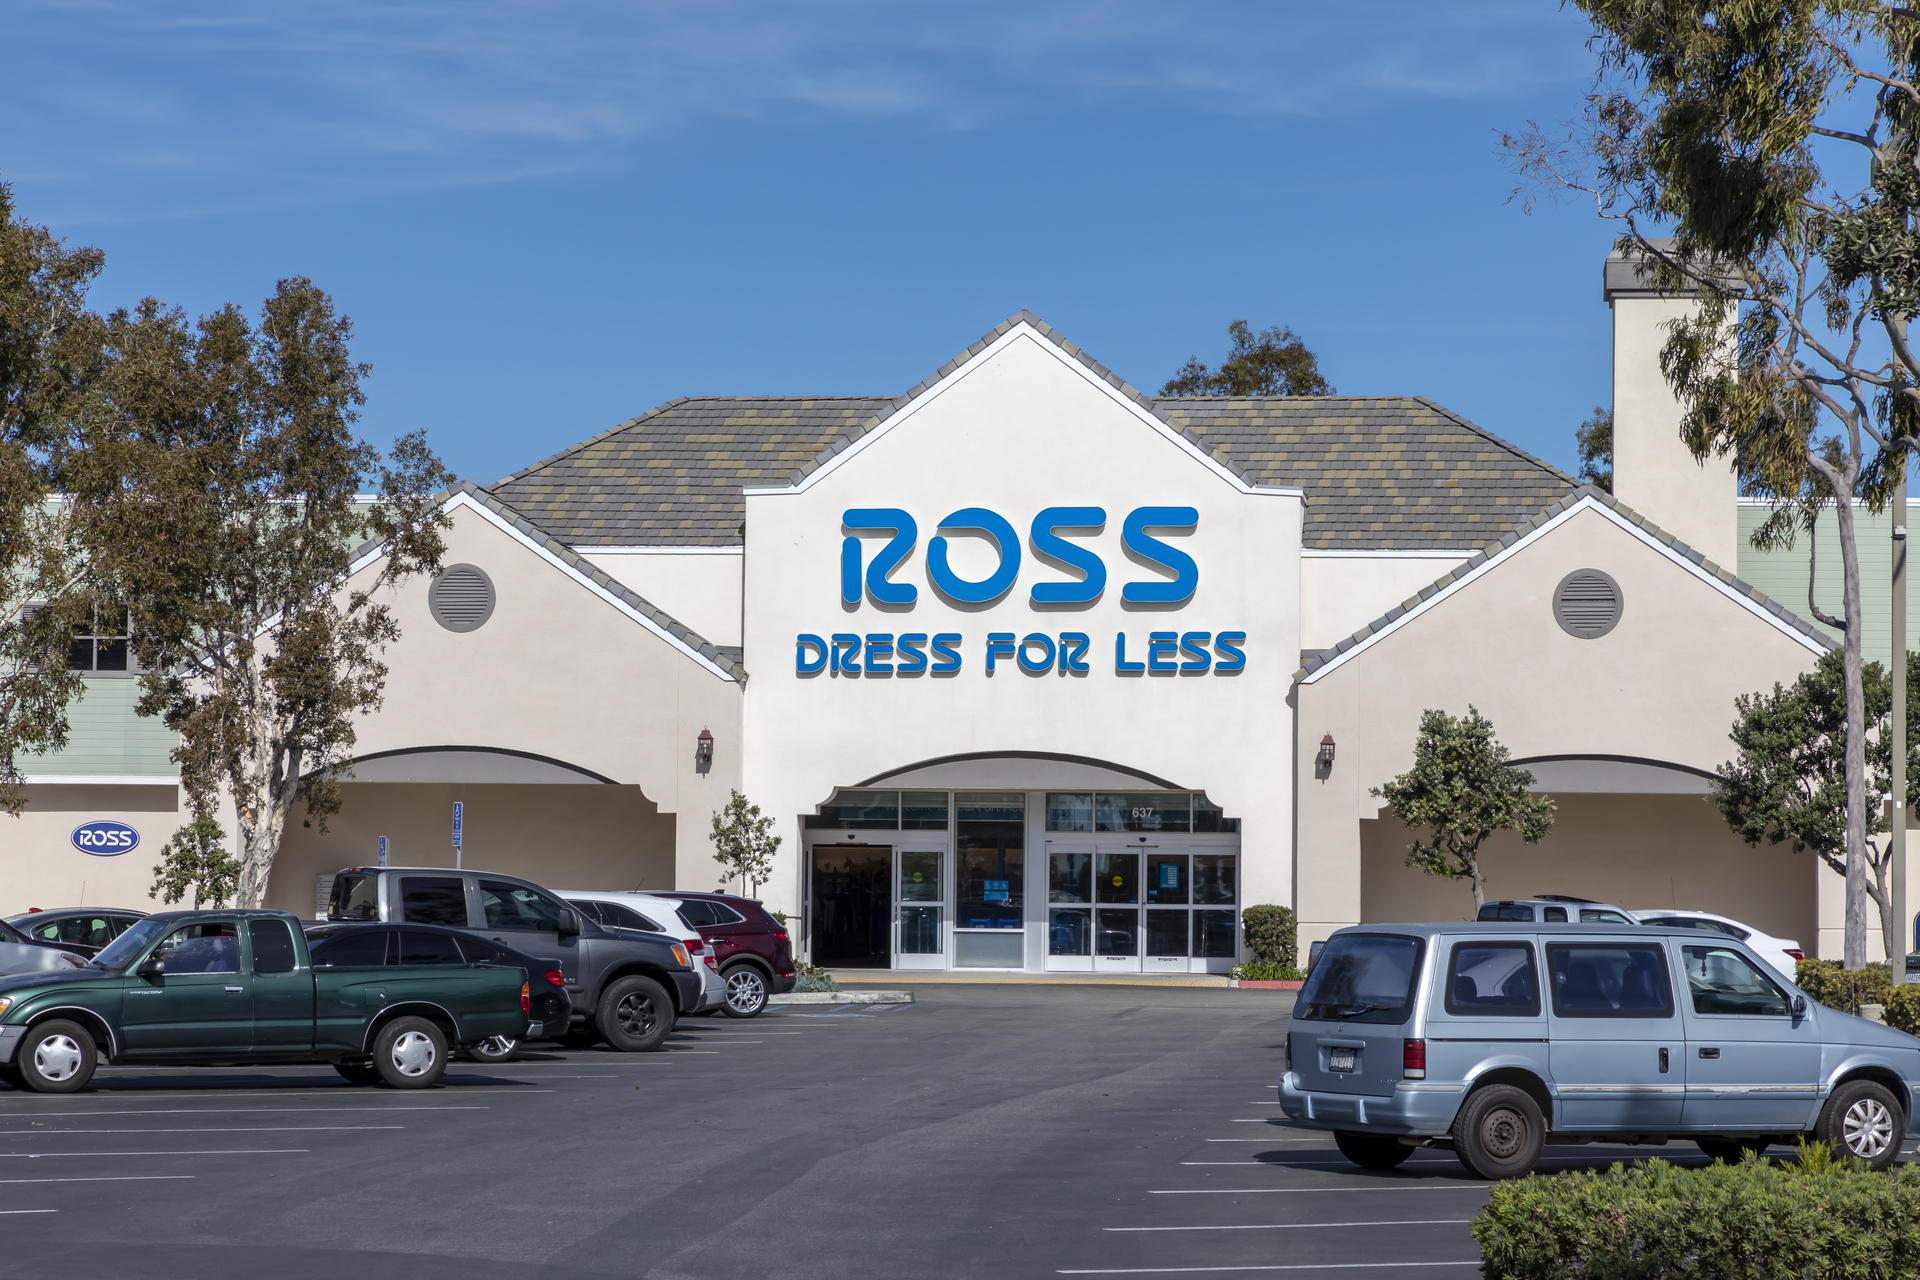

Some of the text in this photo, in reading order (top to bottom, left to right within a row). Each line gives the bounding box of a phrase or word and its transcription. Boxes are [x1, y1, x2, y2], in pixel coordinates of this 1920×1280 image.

[842, 506, 1199, 604] ROSS
[796, 631, 1247, 674] DRESS FOR LESS
[1132, 807, 1153, 818] 637
[79, 830, 132, 847] ROSS
